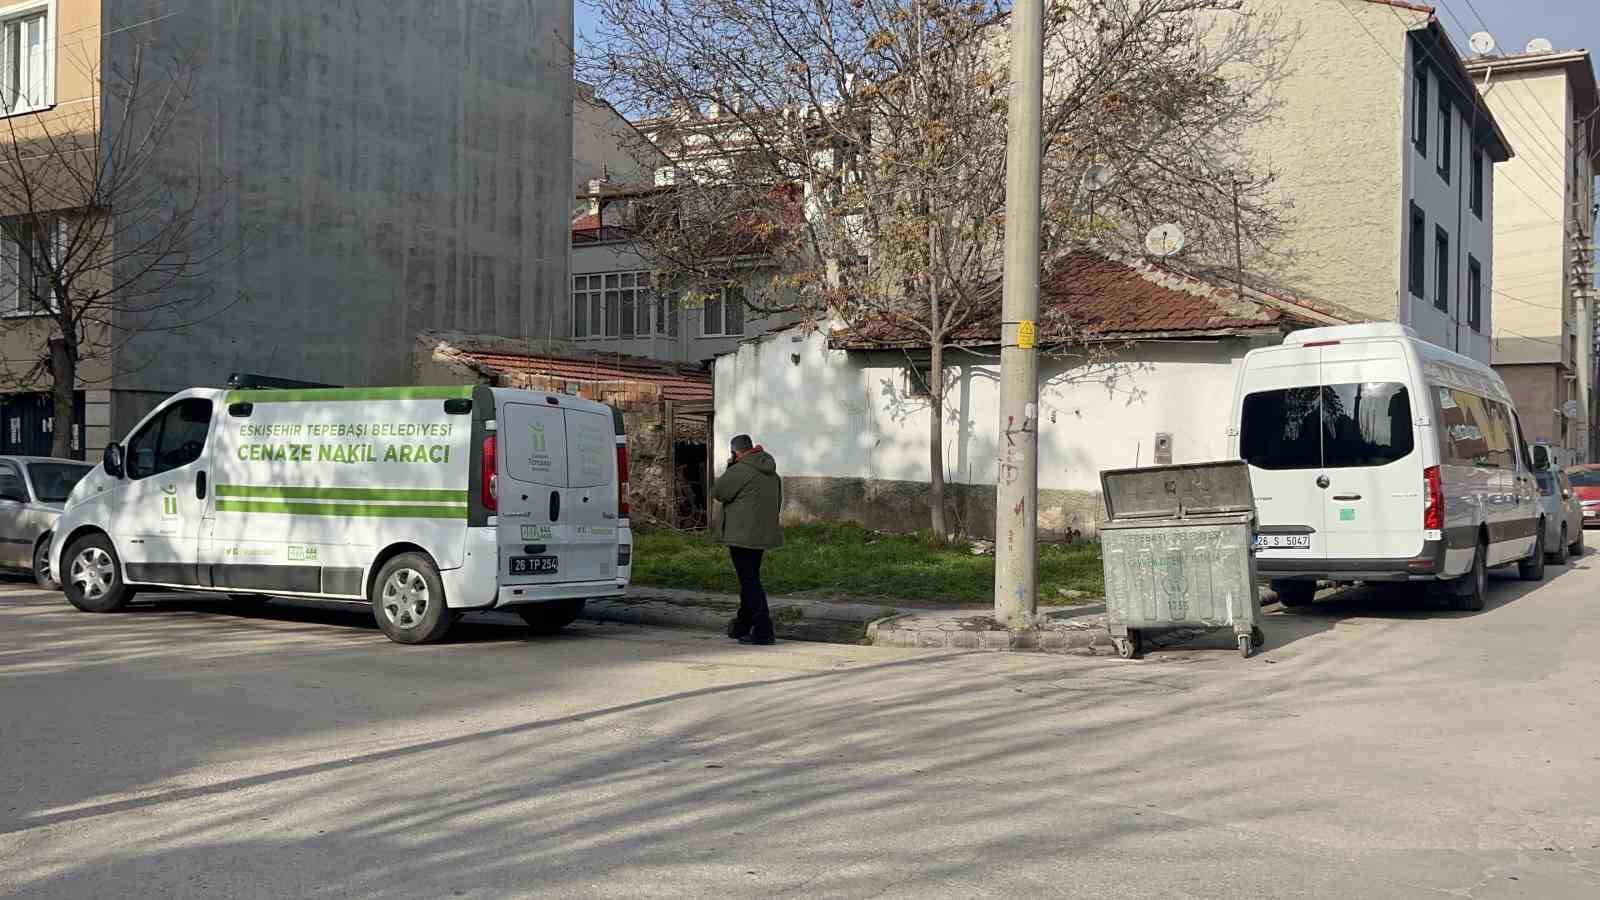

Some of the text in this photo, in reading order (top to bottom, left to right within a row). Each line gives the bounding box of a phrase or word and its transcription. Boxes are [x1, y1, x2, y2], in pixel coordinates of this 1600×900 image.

[307, 423, 368, 438] TEPEBAŞI
[371, 423, 452, 437] BELEDİYESİ
[238, 443, 450, 463] CENAZE NAKİL ARACI
[1258, 536, 1308, 545] 26 S 5047
[515, 558, 557, 570] 26 TP 254
